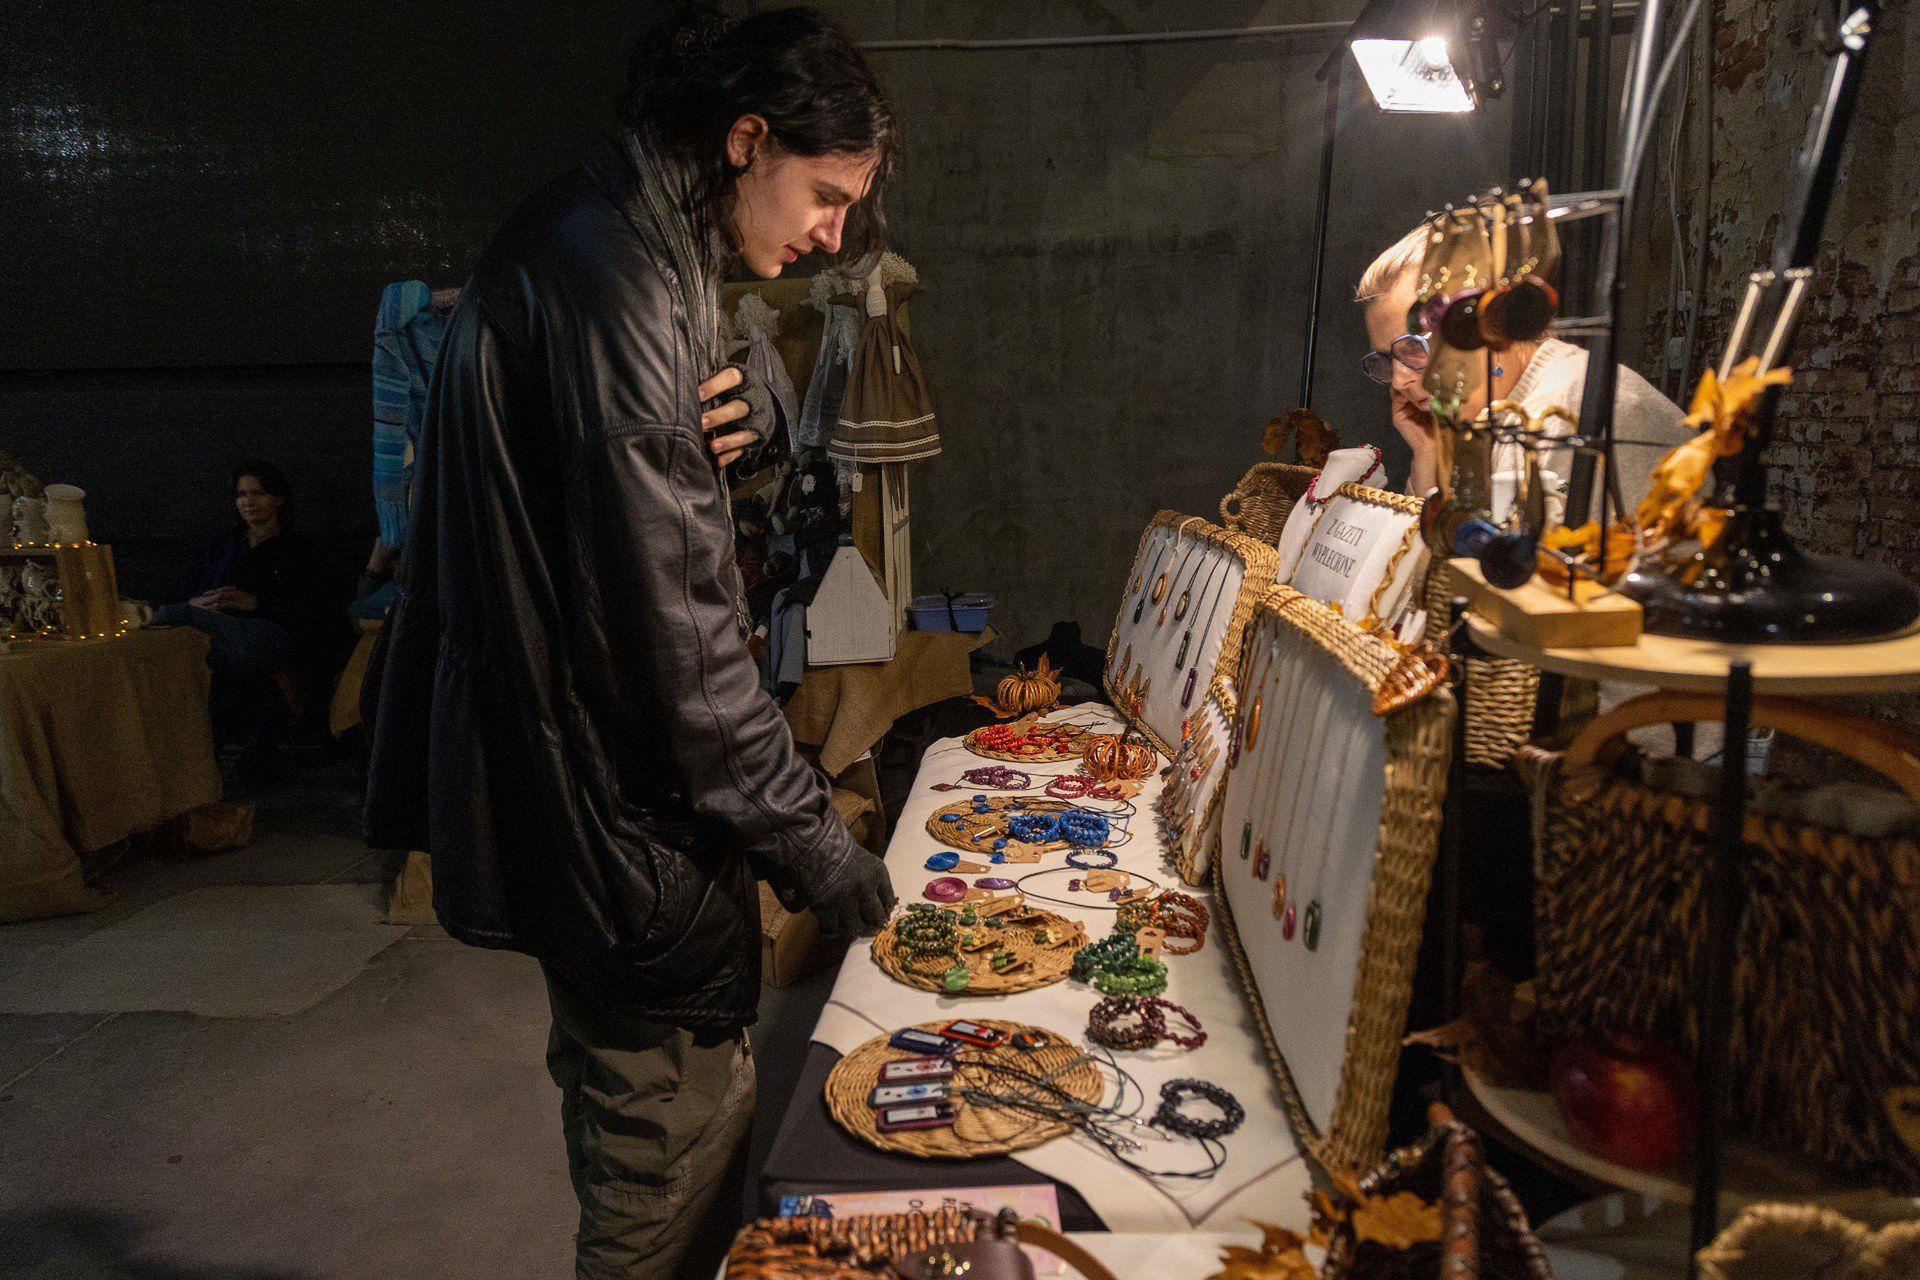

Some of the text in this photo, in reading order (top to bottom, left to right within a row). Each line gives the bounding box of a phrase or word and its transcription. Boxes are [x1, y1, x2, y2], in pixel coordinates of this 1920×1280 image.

[1327, 518, 1365, 546] Z GAZETY
[1312, 542, 1356, 577] WYPLECIONE
